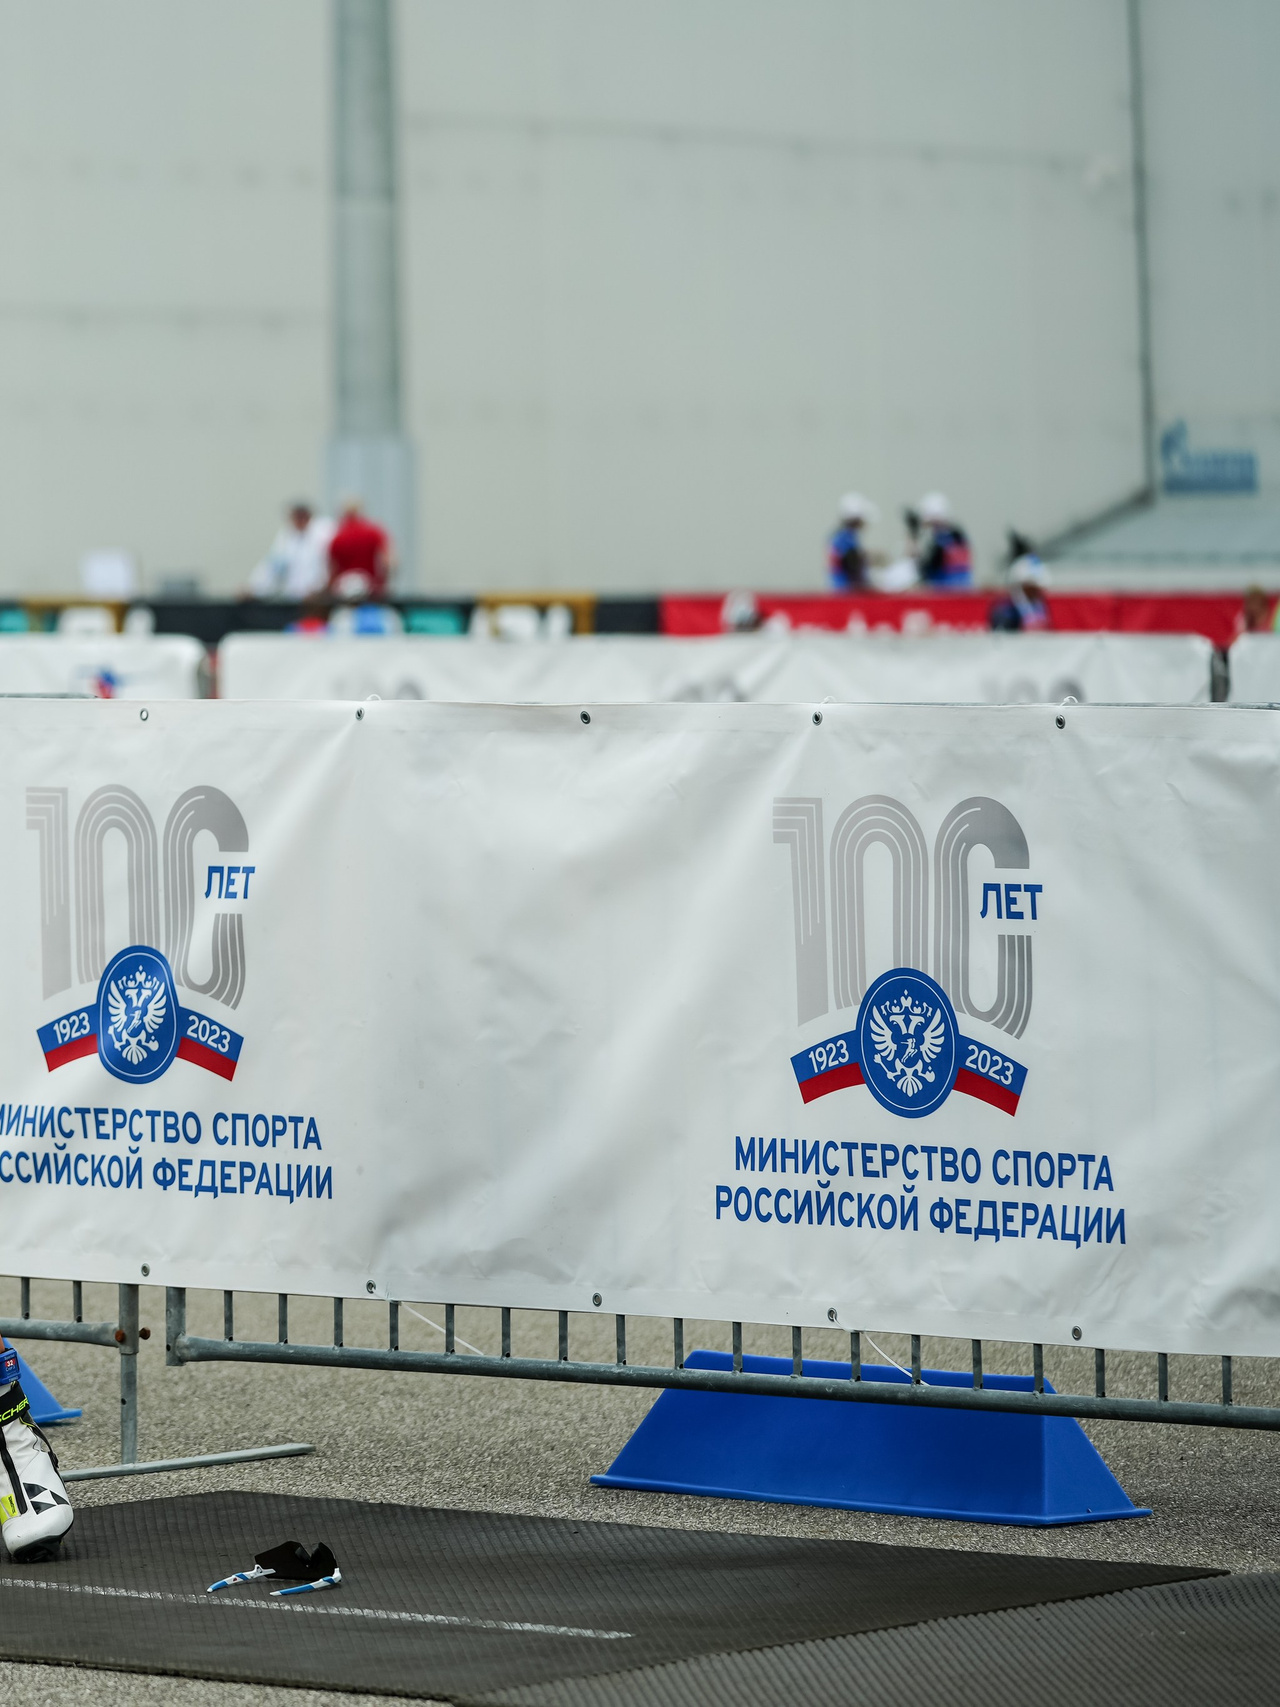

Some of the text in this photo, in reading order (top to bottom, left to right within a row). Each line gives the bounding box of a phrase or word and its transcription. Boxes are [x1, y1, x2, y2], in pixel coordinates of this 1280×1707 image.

[204, 865, 256, 900] ЛЕТ
[979, 882, 1044, 921] ЛЕТ
[52, 1011, 91, 1045] 1923
[186, 1014, 232, 1054] 2023
[808, 1039, 850, 1074] 1923
[964, 1044, 1015, 1086] 2023
[212, 1112, 322, 1151] СПОРТА
[152, 1157, 333, 1205] ФЕДЕРАЦИИ
[734, 1135, 1115, 1192] МИНИСТЕРСТВО СПОРТА
[714, 1179, 1127, 1250] РОССИЙСКОЙ ФЕДЕРАЦИИ
[6, 1359, 14, 1367] 32
